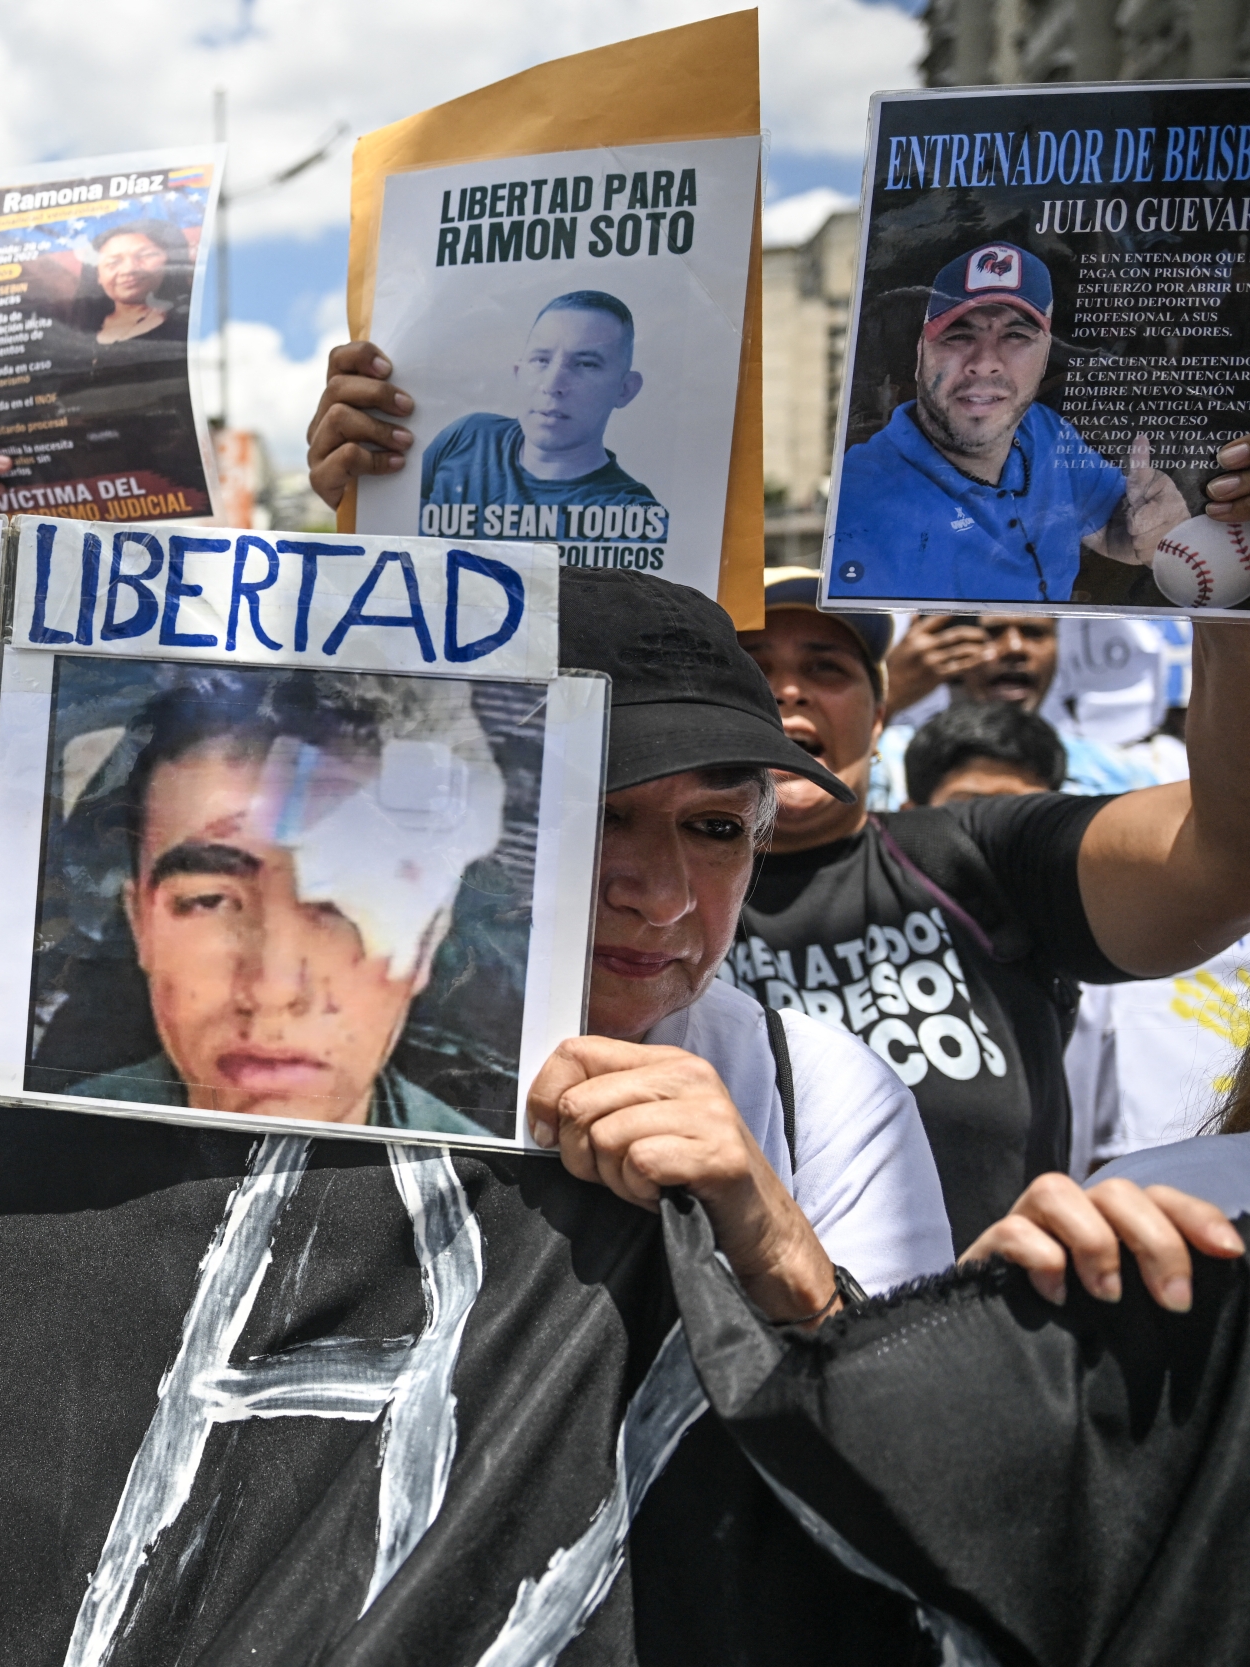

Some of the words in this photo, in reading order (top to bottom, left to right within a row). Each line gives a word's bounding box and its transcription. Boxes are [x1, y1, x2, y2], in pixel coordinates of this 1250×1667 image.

[884, 129, 1103, 190] ENTRENADOR
[1110, 127, 1156, 184] DE
[3, 182, 103, 214] Ramona
[109, 174, 164, 198] Díaz
[440, 175, 594, 224] LIBERTAD
[603, 168, 697, 211] PARA
[1036, 198, 1128, 234] JULIO
[435, 216, 578, 267] RAMON
[588, 210, 695, 258] SOTO
[1081, 254, 1097, 264] ES
[1101, 253, 1121, 263] UN
[1124, 252, 1212, 263] ENTENADOR
[1216, 252, 1246, 264] QUE
[1079, 268, 1116, 279] PAGA
[1120, 268, 1150, 278] CON
[1154, 265, 1211, 278] PRISIÓN
[1214, 267, 1233, 278] SU
[1077, 283, 1152, 294] ESFUERZO
[1156, 282, 1185, 293] POR
[1187, 282, 1232, 293] ABRIR
[1076, 298, 1135, 308] FUTURO
[1138, 297, 1221, 308] DEPORTIVO
[1074, 312, 1175, 323] PROFESIONAL
[1180, 312, 1189, 322] A
[1193, 311, 1218, 322] SUS
[1071, 327, 1137, 338] JOVENES
[1143, 326, 1233, 337] JUGADORES.
[1068, 357, 1085, 367] SE
[1089, 356, 1178, 367] ENCUENTRA
[1066, 371, 1085, 382] EL
[1088, 371, 1148, 382] CENTRO
[1064, 386, 1128, 397] HOMBRE
[1131, 385, 1183, 396] NUEVO
[1185, 383, 1236, 396] SIMÓN
[1062, 398, 1126, 411] BOLÍVAR
[1137, 400, 1204, 411] ANTIGUA
[1060, 415, 1128, 426] CARACAS
[1138, 415, 1208, 426] PROCESO
[1057, 430, 1132, 441] MARCADO
[1056, 444, 1075, 455] DE
[1053, 459, 1096, 470] FALTA
[97, 477, 147, 499] DEL
[104, 491, 193, 520] JUDICIAL
[421, 503, 476, 537] QUE
[483, 504, 558, 538] SEAN
[566, 504, 667, 539] TODOS
[28, 523, 526, 663] LIBERTAD
[805, 944, 839, 989] A
